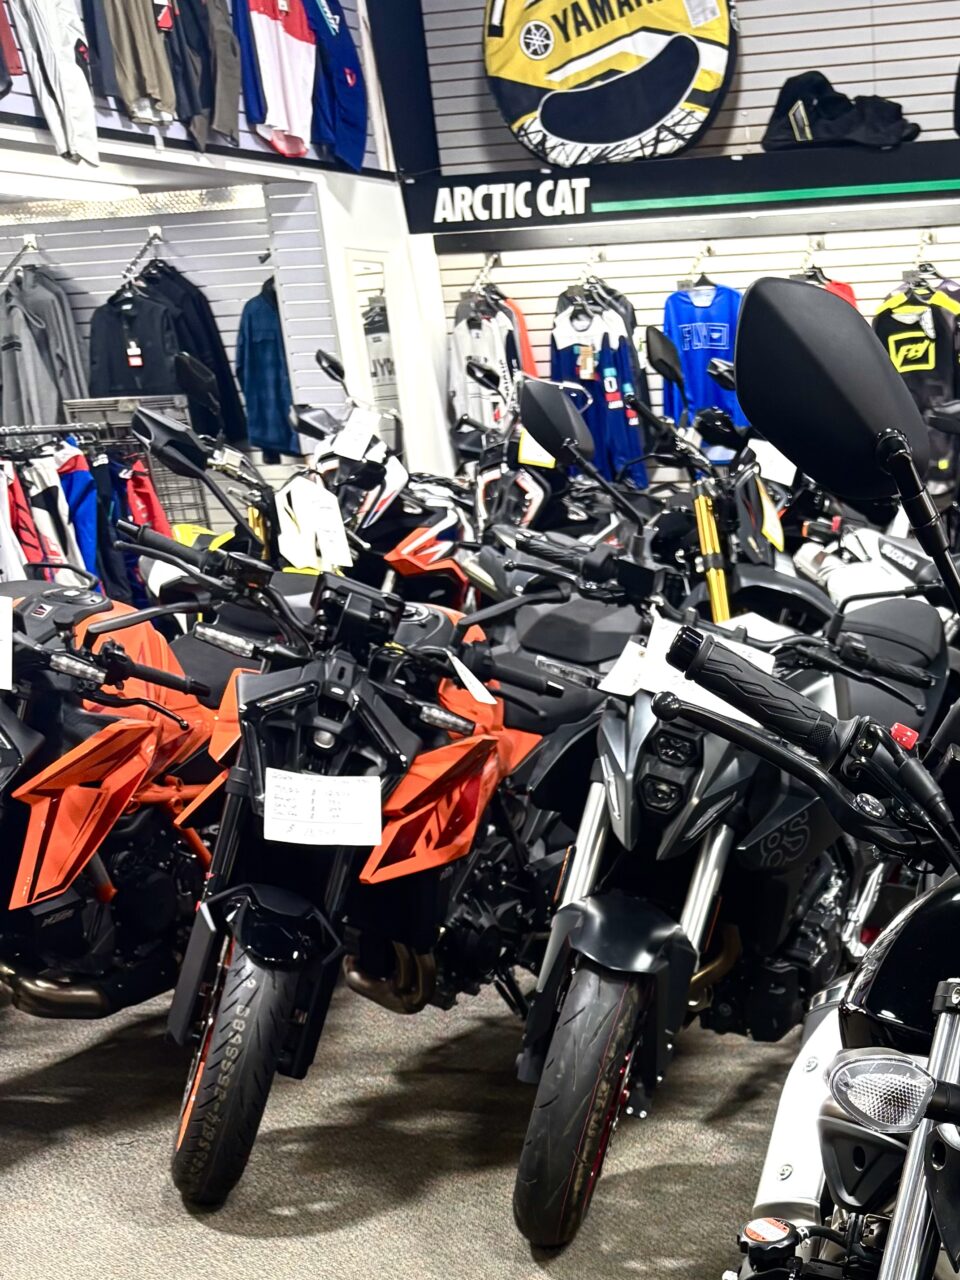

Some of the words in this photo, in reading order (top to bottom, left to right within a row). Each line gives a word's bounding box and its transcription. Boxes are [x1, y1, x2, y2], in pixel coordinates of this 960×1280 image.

[551, 0, 662, 42] YAMA
[433, 181, 532, 223] ARCTIC
[536, 177, 590, 217] CAT
